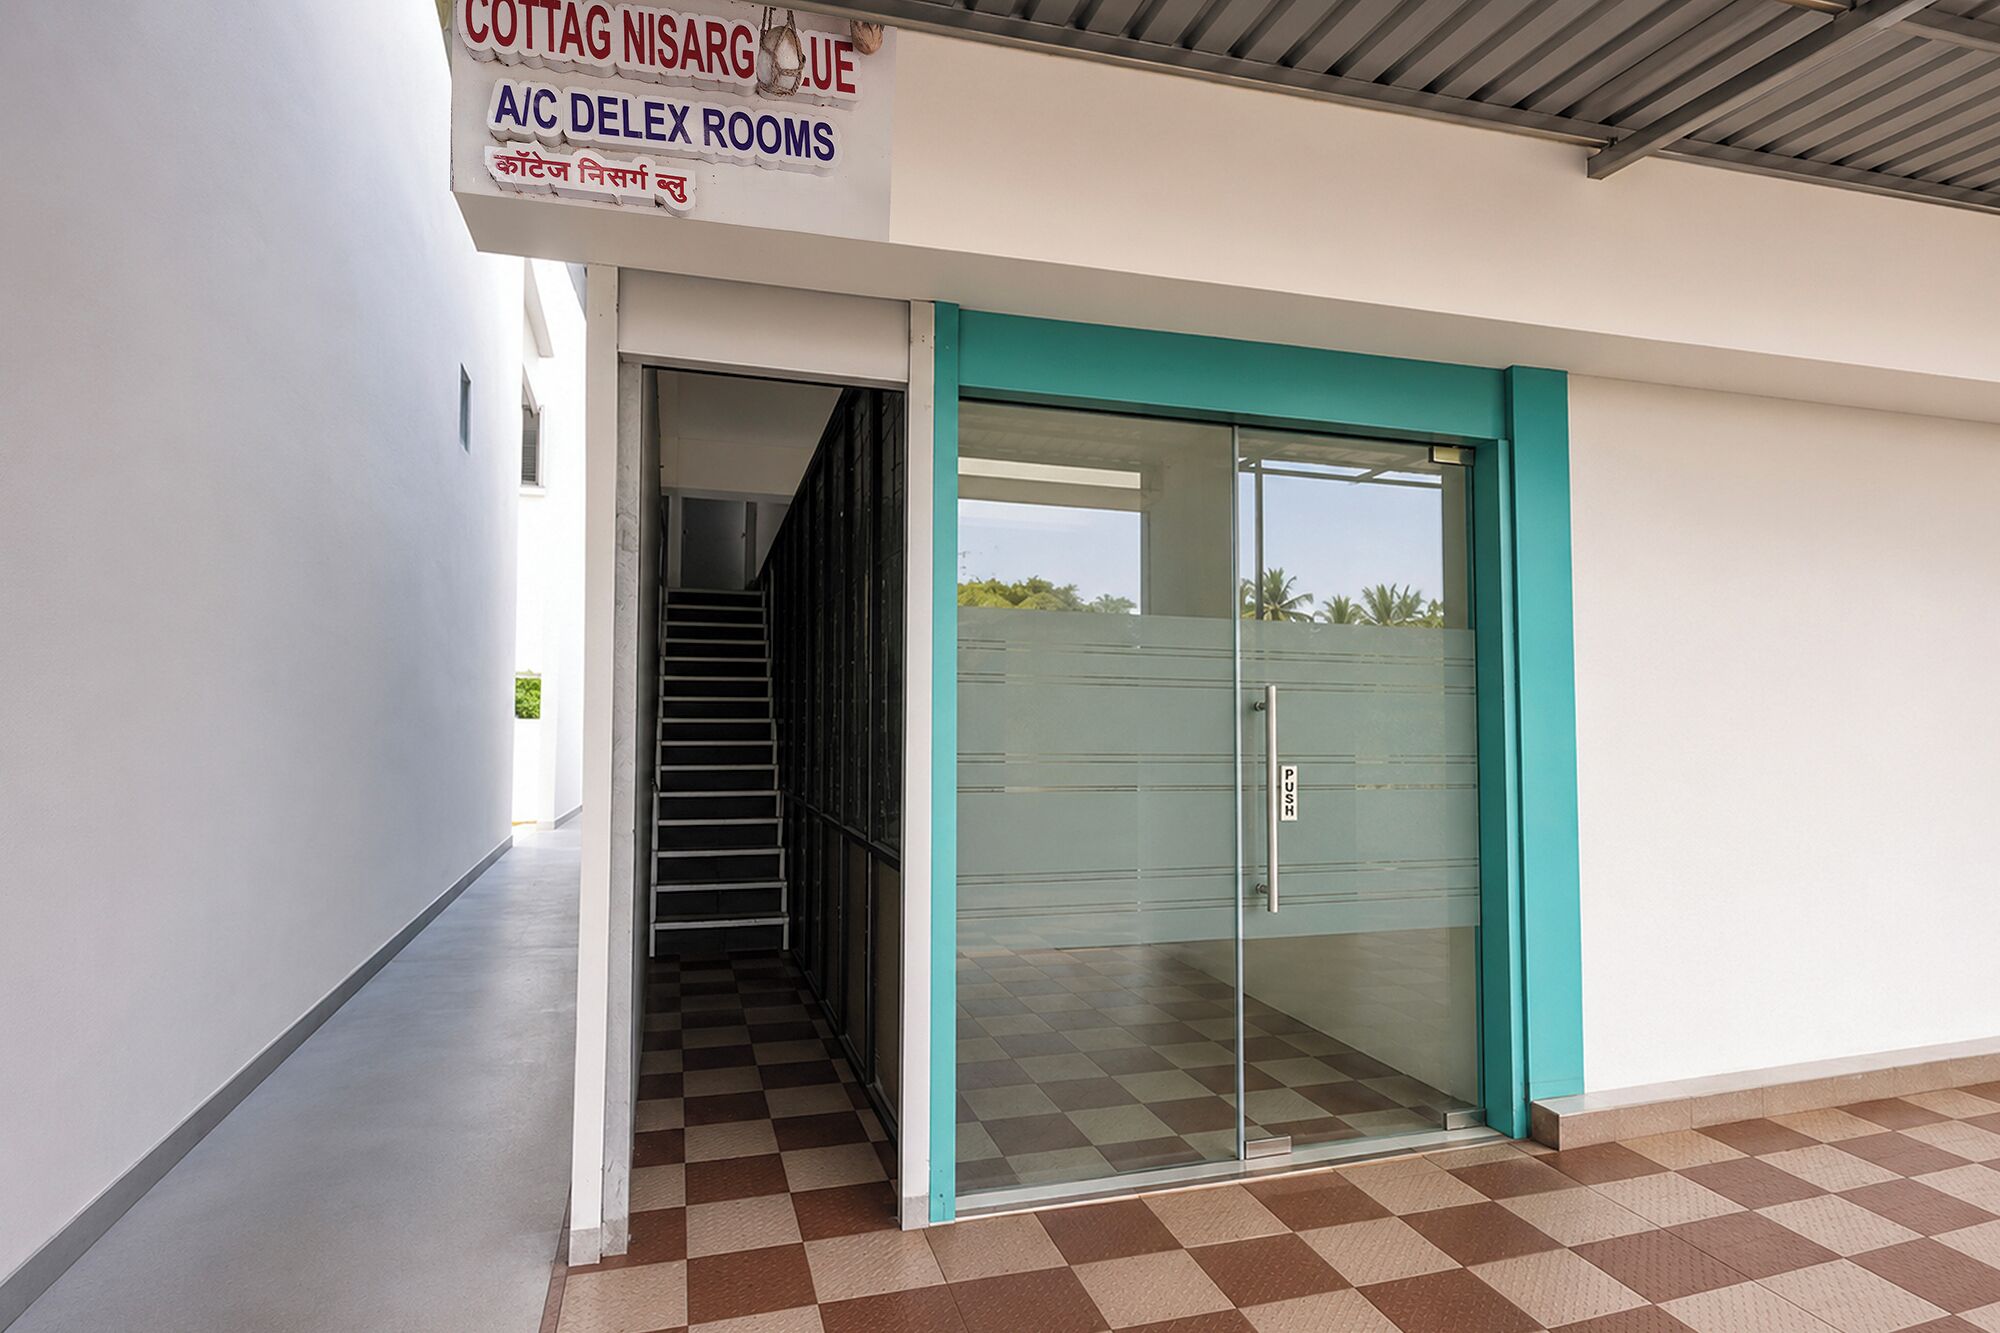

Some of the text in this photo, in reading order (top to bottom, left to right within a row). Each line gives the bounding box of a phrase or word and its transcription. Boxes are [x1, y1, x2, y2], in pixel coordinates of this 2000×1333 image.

[465, 0, 611, 60] COTTAG
[623, 9, 754, 79] NISARG
[495, 84, 835, 161] A/C DELEX ROOMS
[494, 150, 571, 181] कॉटेज
[578, 157, 648, 190] निसर्ग
[1285, 768, 1294, 816] PUSH
